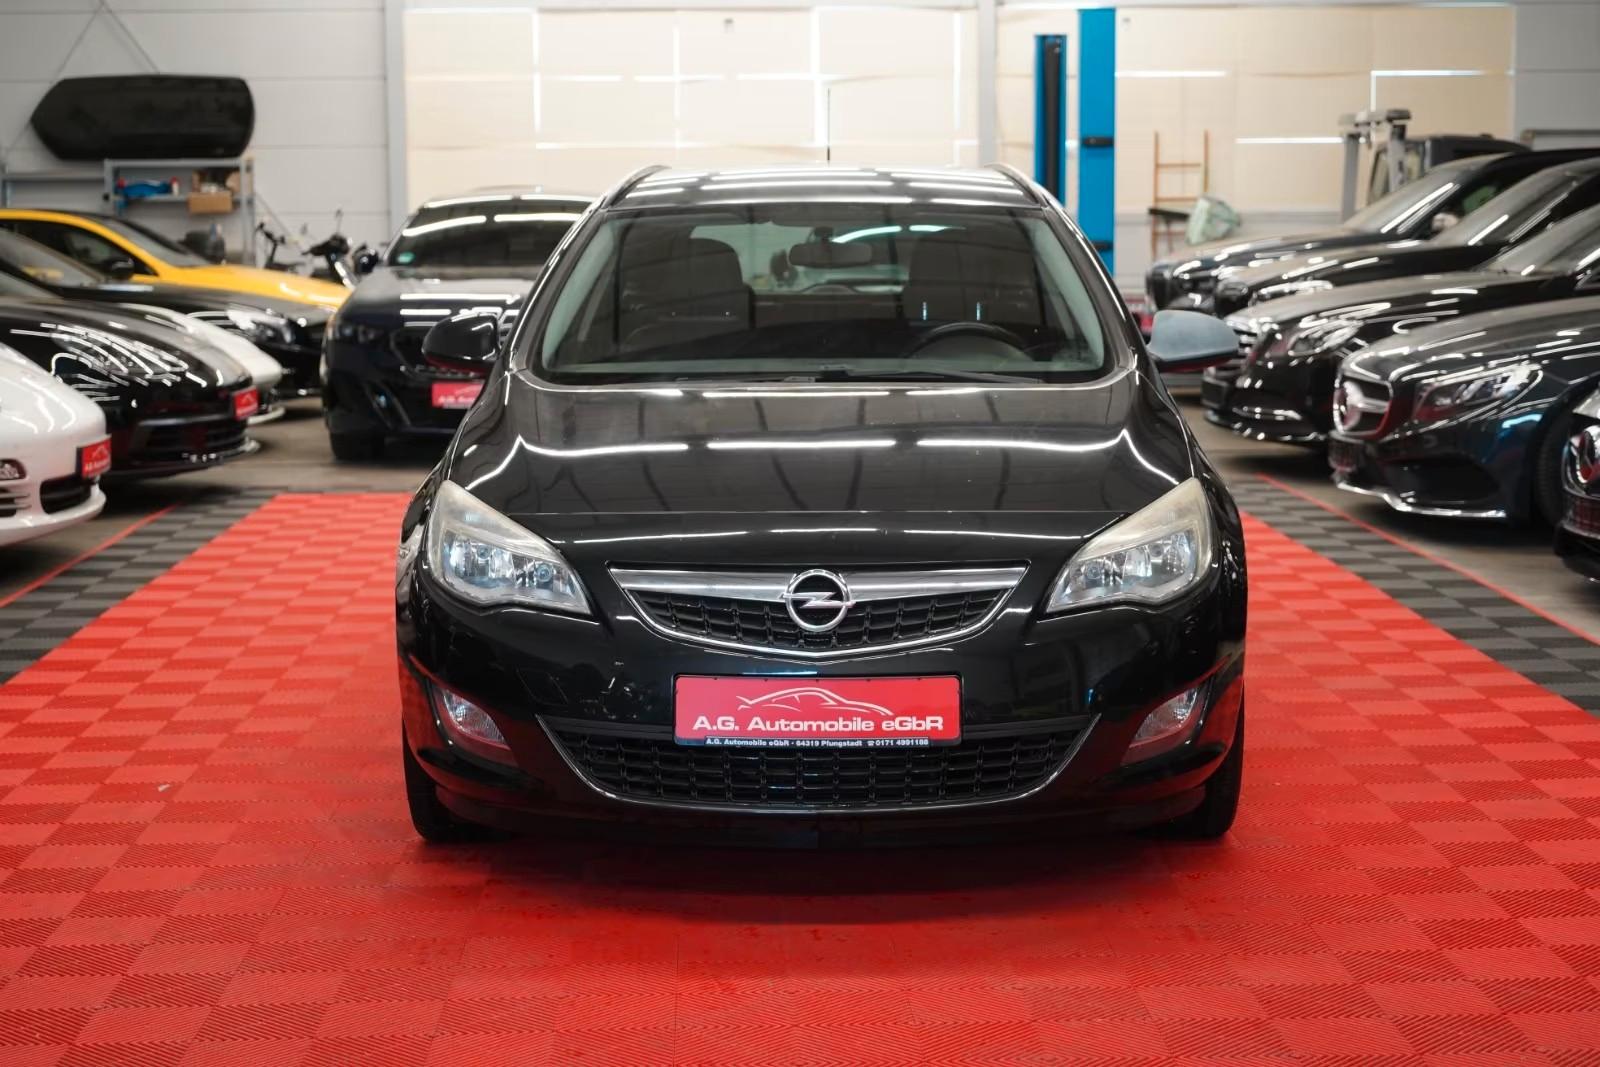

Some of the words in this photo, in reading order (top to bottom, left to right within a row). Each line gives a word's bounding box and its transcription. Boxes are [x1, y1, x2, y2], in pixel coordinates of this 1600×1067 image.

[692, 716, 740, 731] A.G.
[747, 716, 875, 732] Automobile
[881, 715, 944, 731] eGbR
[724, 738, 767, 746] Automobile
[821, 740, 862, 748] Pfungstadt
